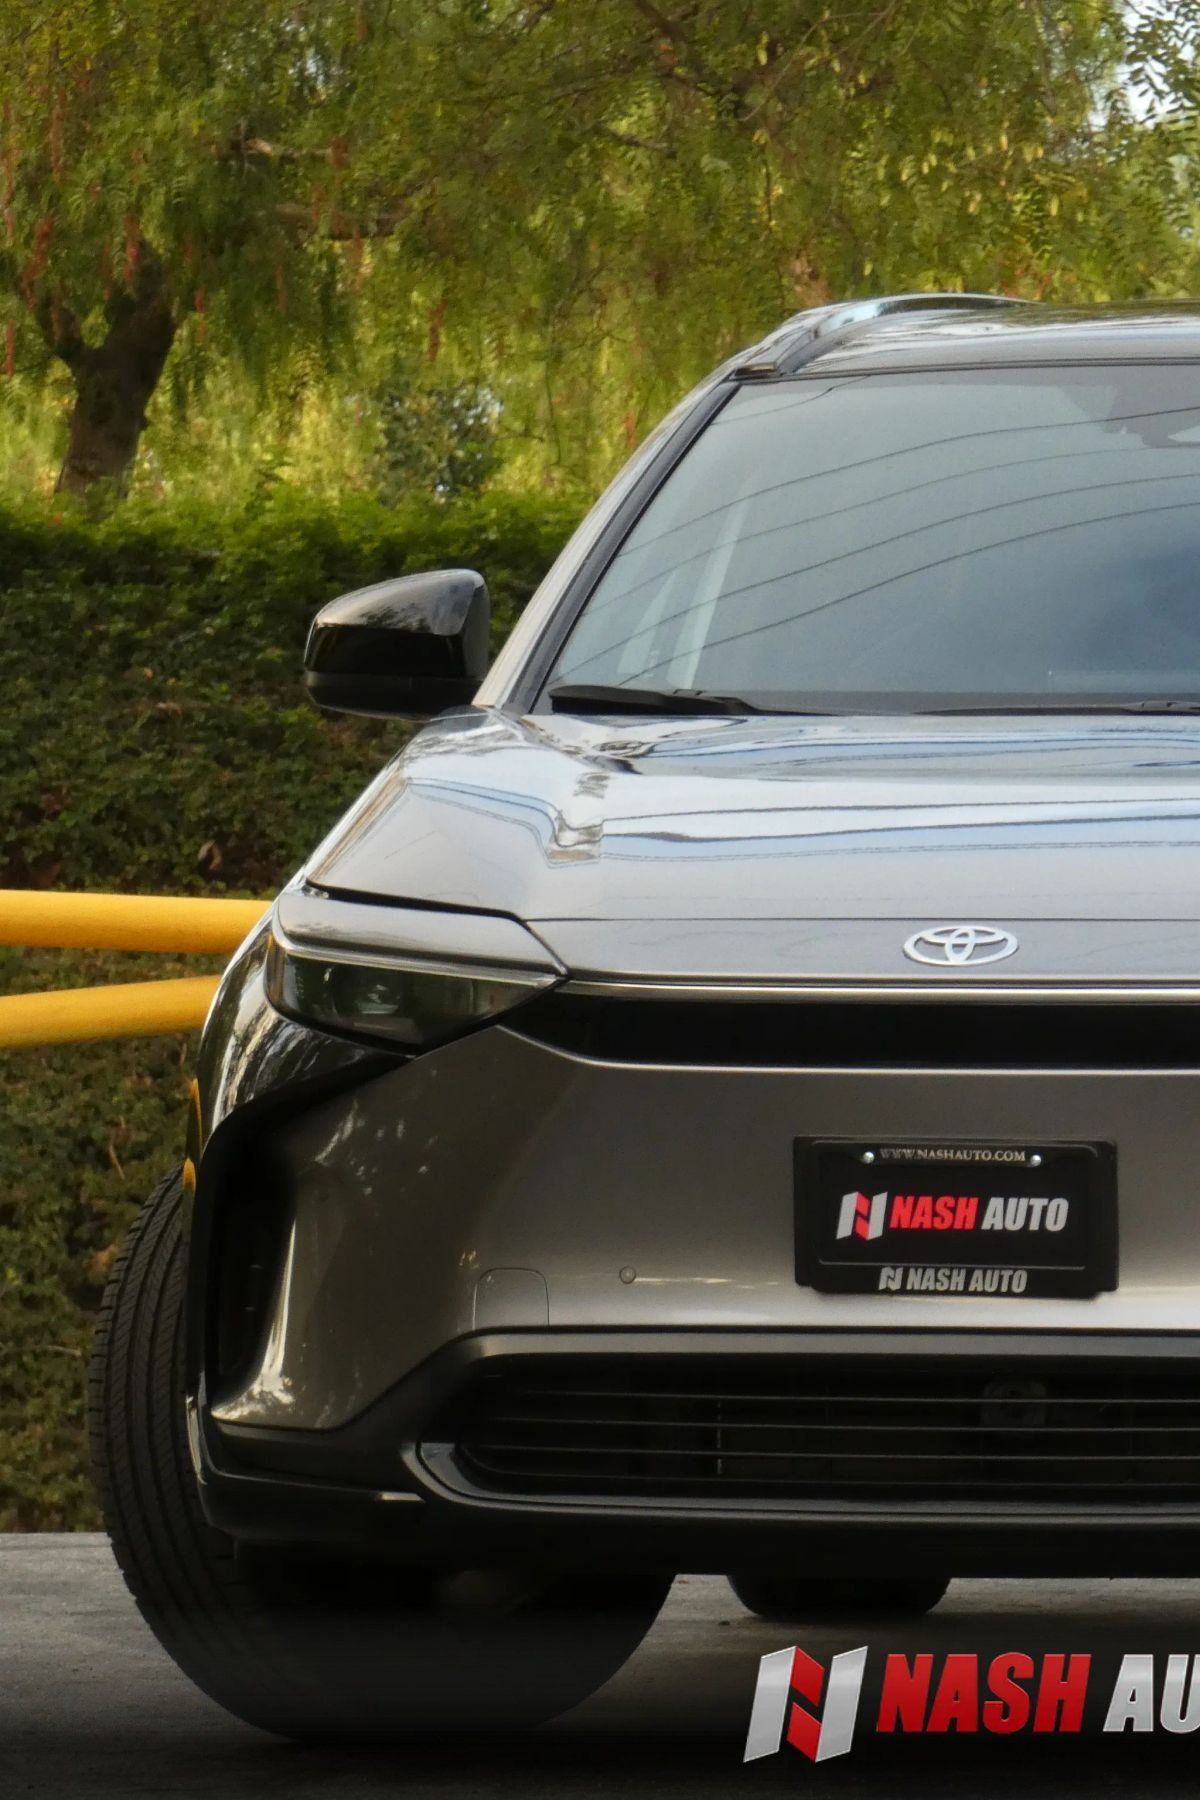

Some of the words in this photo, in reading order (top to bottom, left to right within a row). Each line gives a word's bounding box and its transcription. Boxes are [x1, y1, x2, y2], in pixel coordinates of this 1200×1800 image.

[880, 1148, 1026, 1162] WWW.NASHAUTO.COM
[889, 1195, 979, 1231] NASH
[981, 1197, 1069, 1232] AUTO
[905, 1266, 967, 1292] NASH
[969, 1268, 1028, 1293] AUTO
